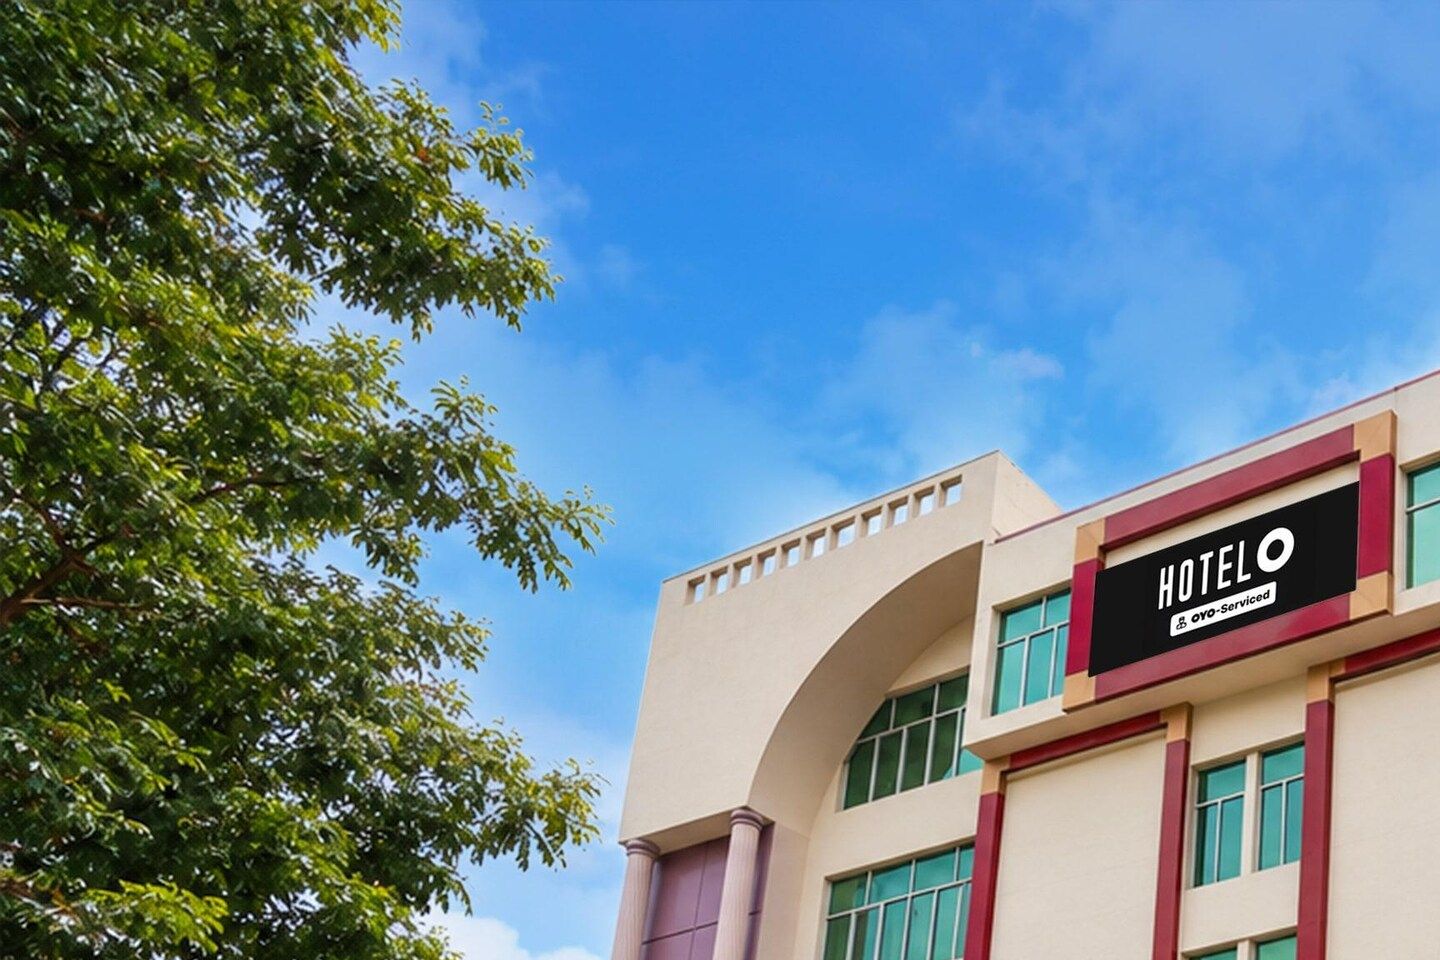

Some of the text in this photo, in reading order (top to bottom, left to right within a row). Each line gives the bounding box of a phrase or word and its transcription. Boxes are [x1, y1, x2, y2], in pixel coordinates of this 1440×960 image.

[1158, 527, 1295, 610] HOTEL O
[1191, 589, 1270, 623] OYO-Serviced
